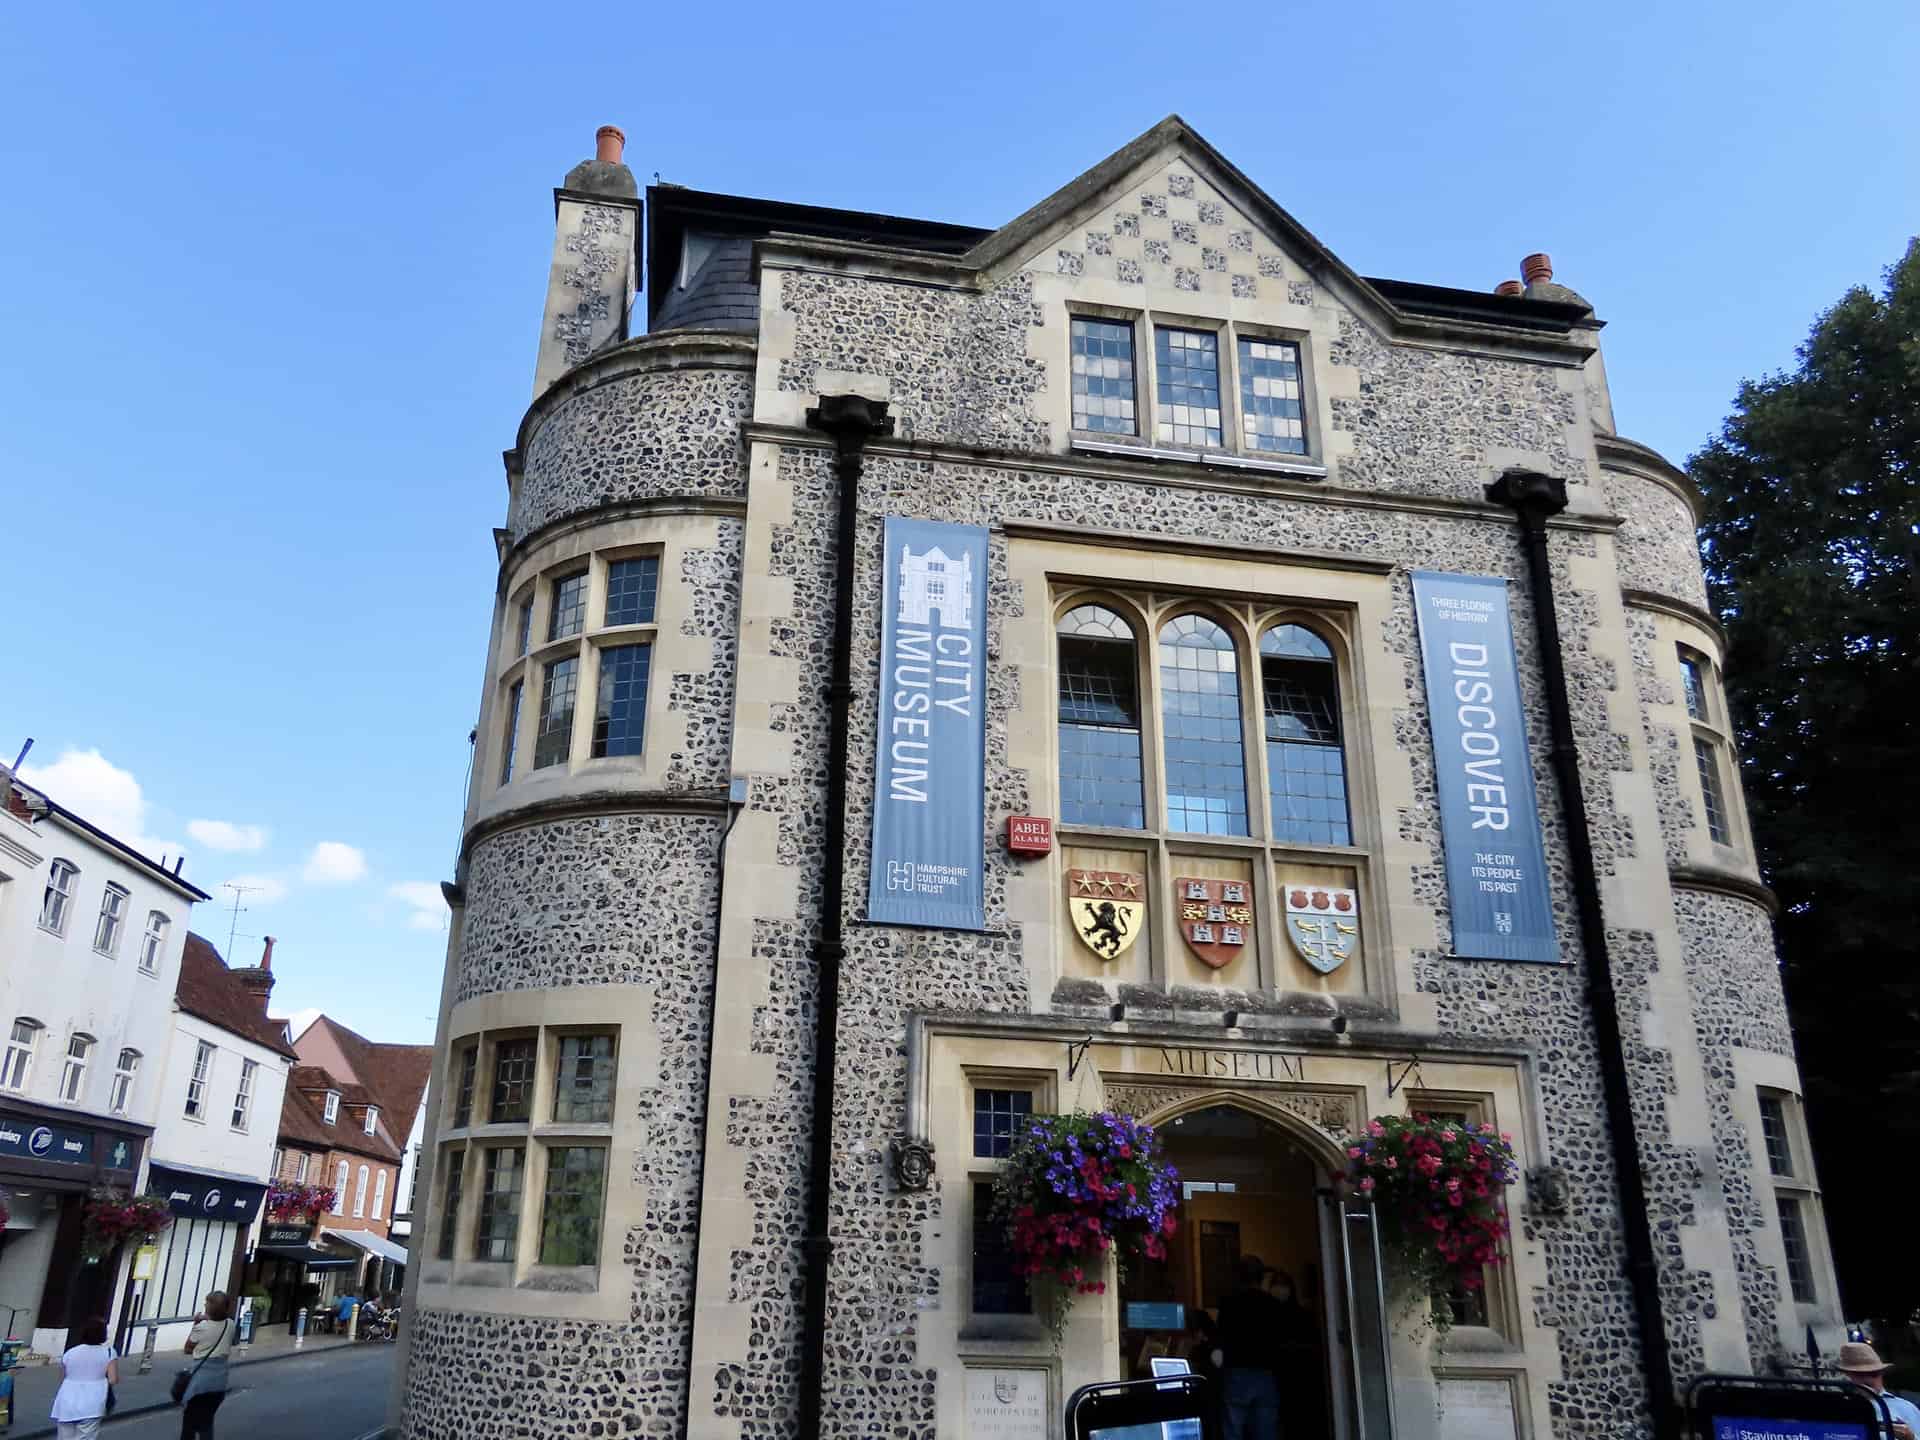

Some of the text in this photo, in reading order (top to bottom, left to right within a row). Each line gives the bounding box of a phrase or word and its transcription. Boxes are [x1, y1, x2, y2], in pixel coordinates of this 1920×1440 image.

[1432, 597, 1459, 608] THREE
[935, 633, 972, 716] CITY
[890, 628, 932, 802] MUSEUM
[1449, 642, 1509, 831] DISCOVER
[1014, 822, 1049, 835] ABEL
[1014, 835, 1049, 844] ALARM
[1475, 853, 1515, 865] THE CITY
[917, 863, 969, 878] HAMPSHIRE
[1472, 866, 1523, 880] ITS PEOPLE
[916, 873, 961, 886] CULTURAL
[917, 883, 944, 894] TRUST
[1480, 880, 1517, 894] ITS PAST
[1159, 1048, 1304, 1081] MUSEUM
